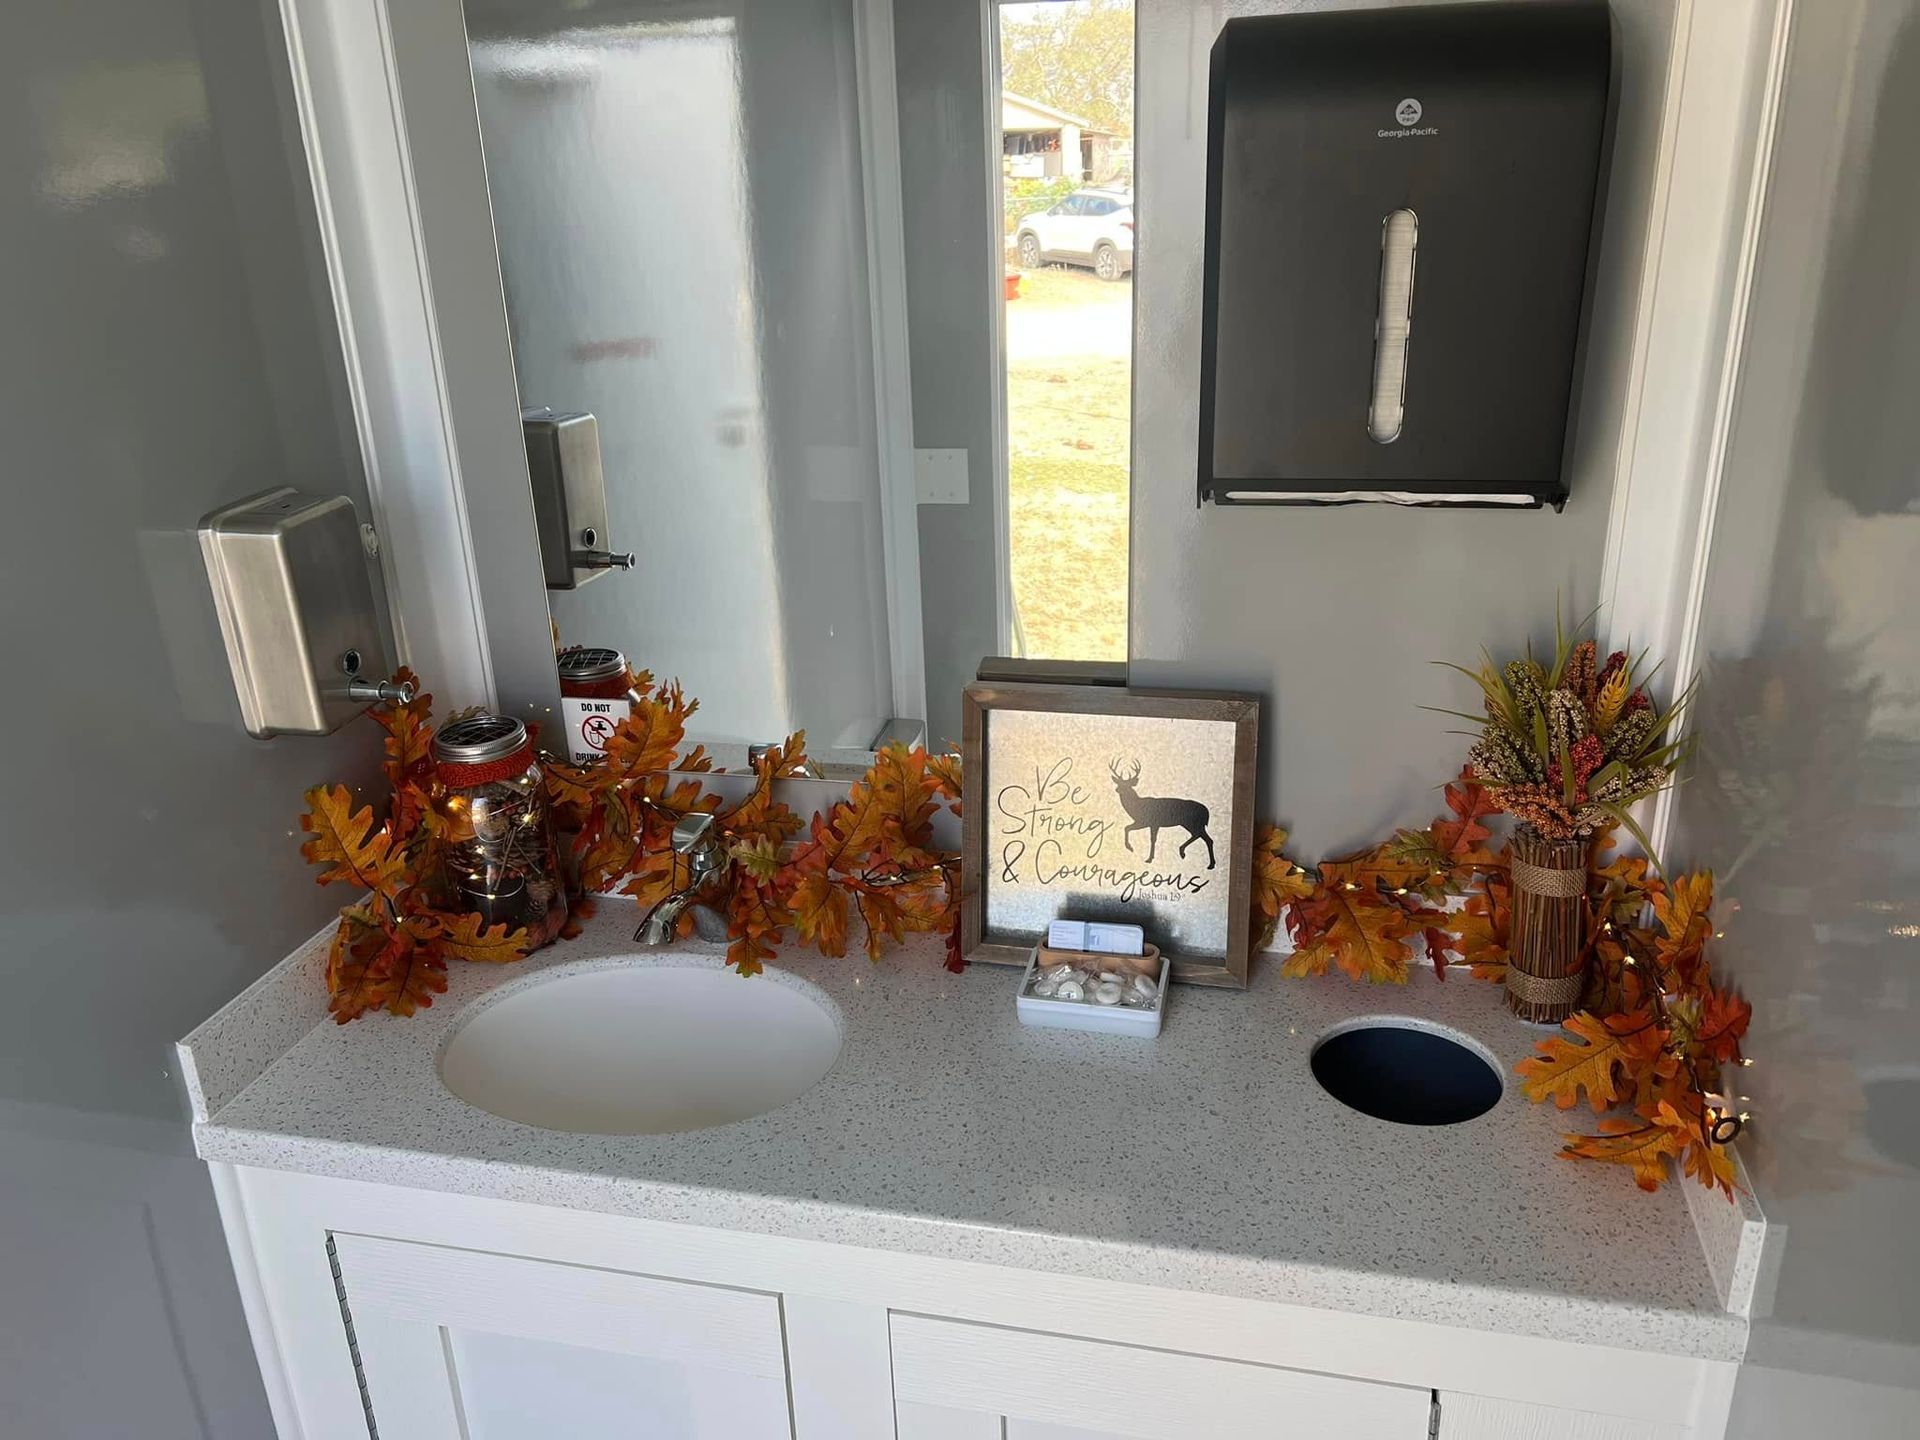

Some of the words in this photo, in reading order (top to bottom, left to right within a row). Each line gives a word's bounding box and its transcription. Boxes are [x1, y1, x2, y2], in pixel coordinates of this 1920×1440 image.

[581, 703, 593, 712] DO
[594, 704, 611, 713] NOT
[1036, 757, 1091, 804] Be
[998, 785, 1115, 859] Strong
[1002, 840, 1025, 884] &
[1036, 839, 1210, 903] Courageous
